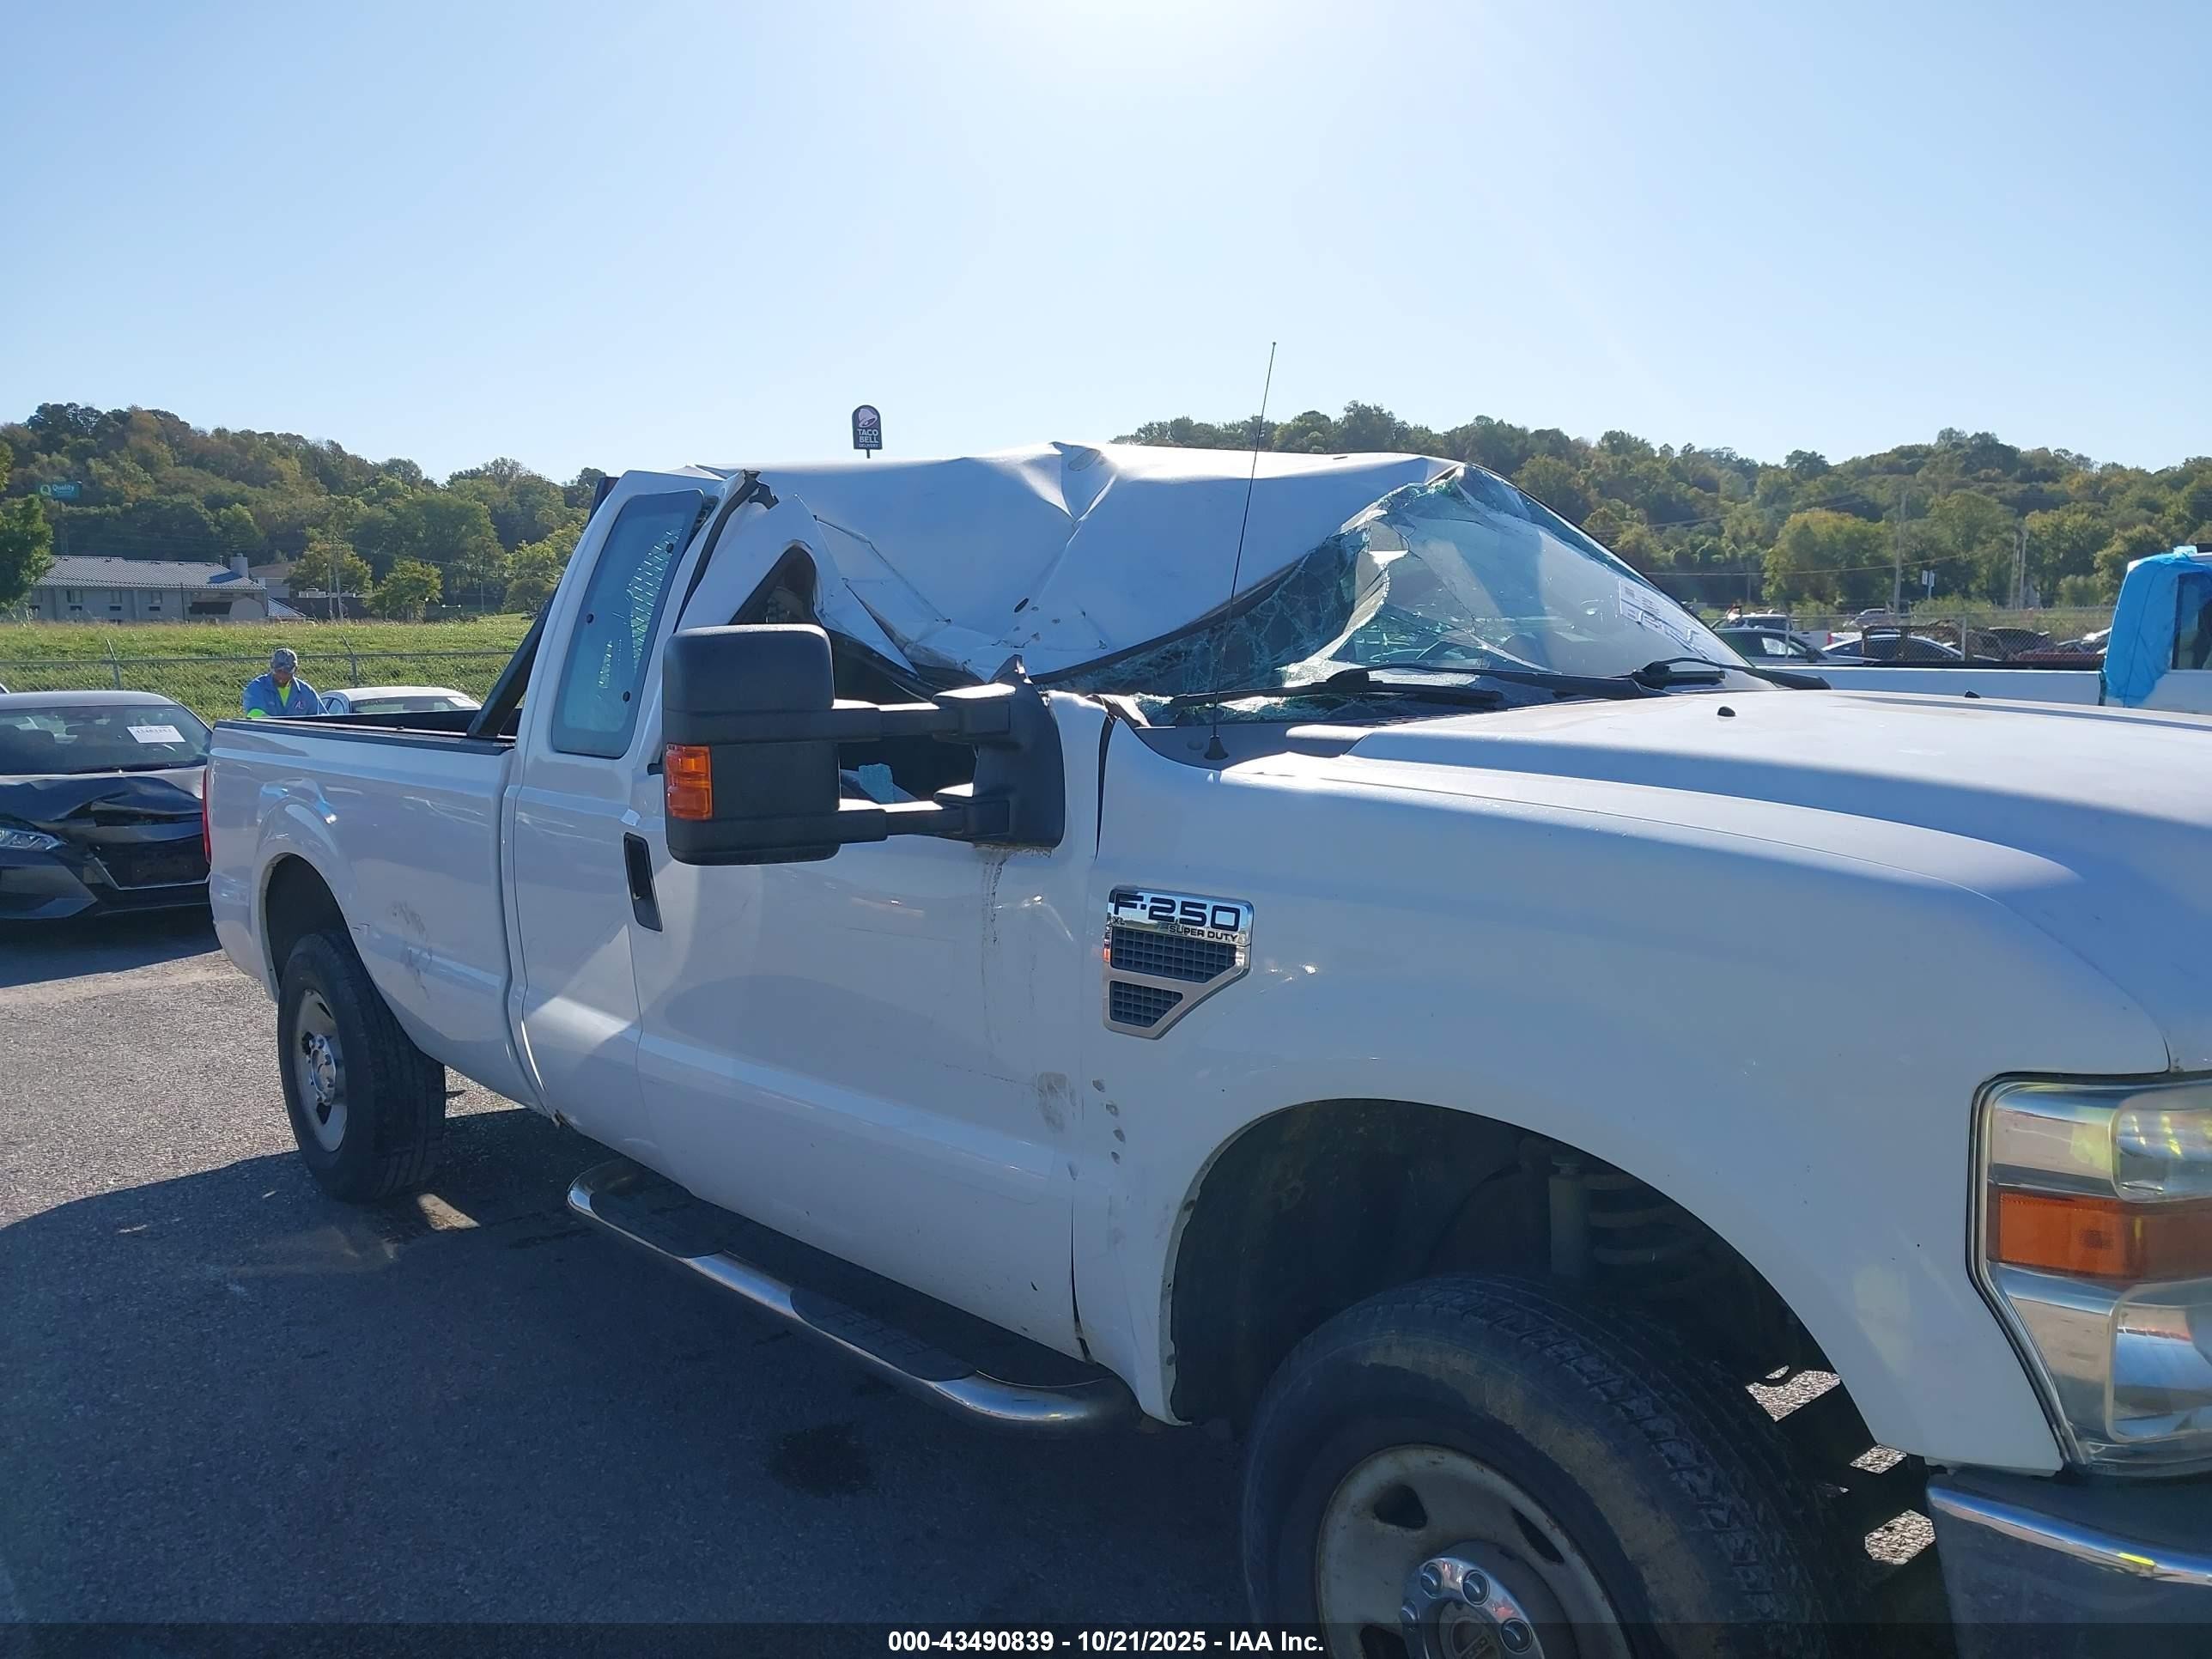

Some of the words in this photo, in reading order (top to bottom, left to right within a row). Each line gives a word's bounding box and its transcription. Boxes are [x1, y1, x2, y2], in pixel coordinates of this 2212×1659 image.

[52, 483, 75, 492] Quality
[1113, 892, 1241, 933] F-250
[1113, 915, 1126, 926] XL
[1169, 925, 1205, 938] SUPER
[1207, 930, 1239, 942] DUTY
